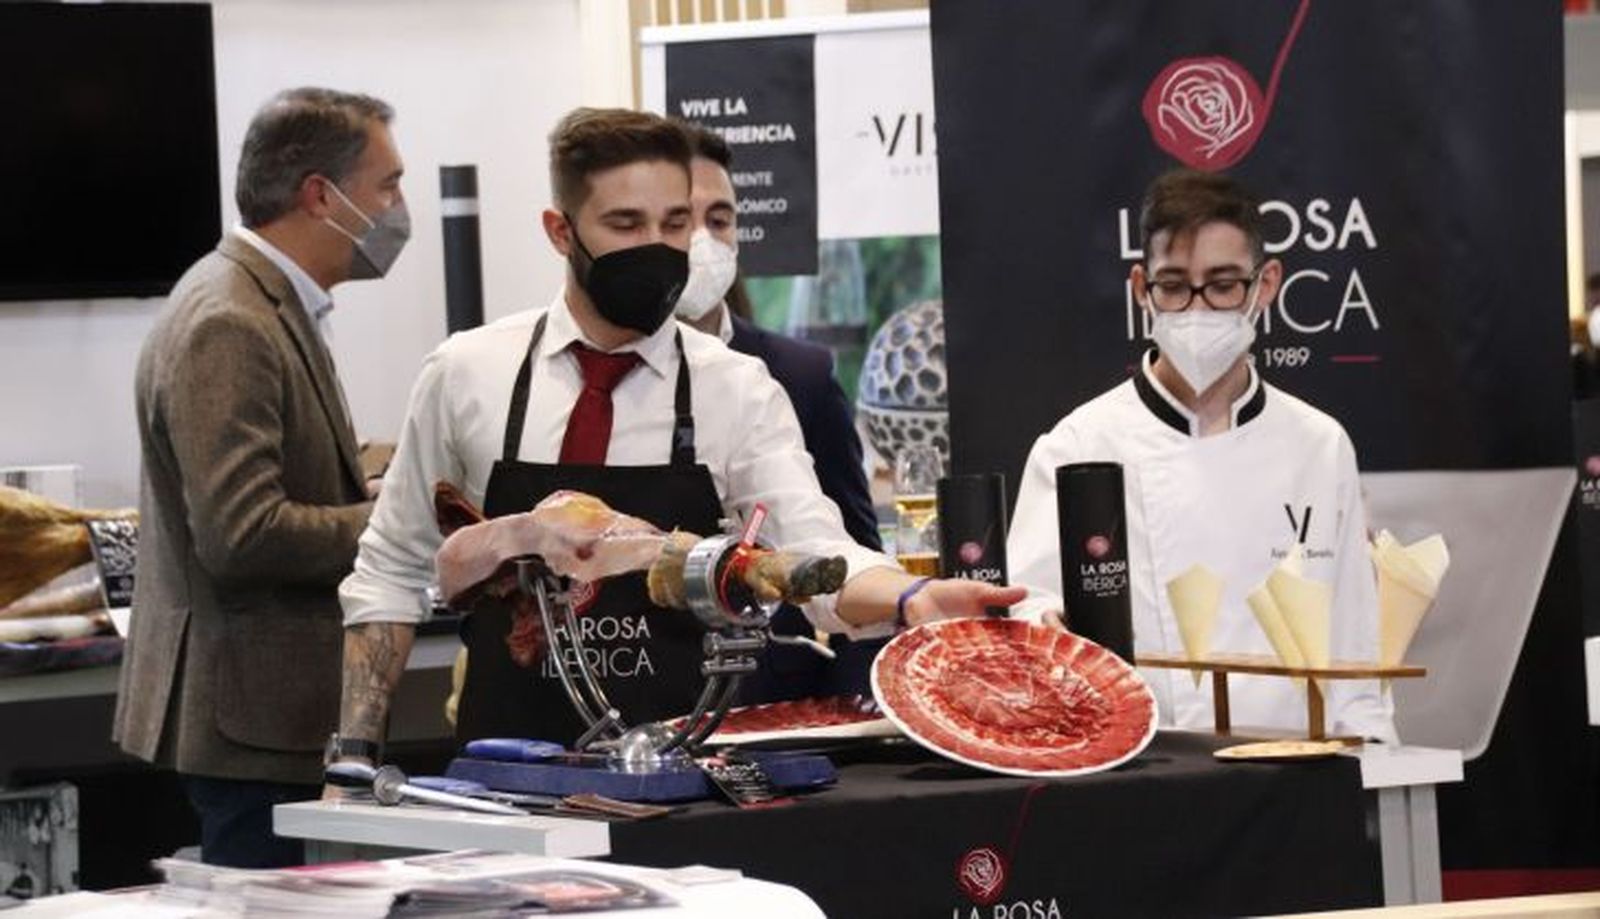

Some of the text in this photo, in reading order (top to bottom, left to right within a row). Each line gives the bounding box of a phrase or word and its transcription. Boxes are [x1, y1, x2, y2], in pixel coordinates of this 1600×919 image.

[681, 97, 748, 117] VIVE LA
[873, 113, 937, 157] VI
[1118, 198, 1378, 260] L OSA
[1264, 346, 1311, 368] 1989
[1081, 563, 1096, 576] LA
[581, 615, 651, 641] ROSA
